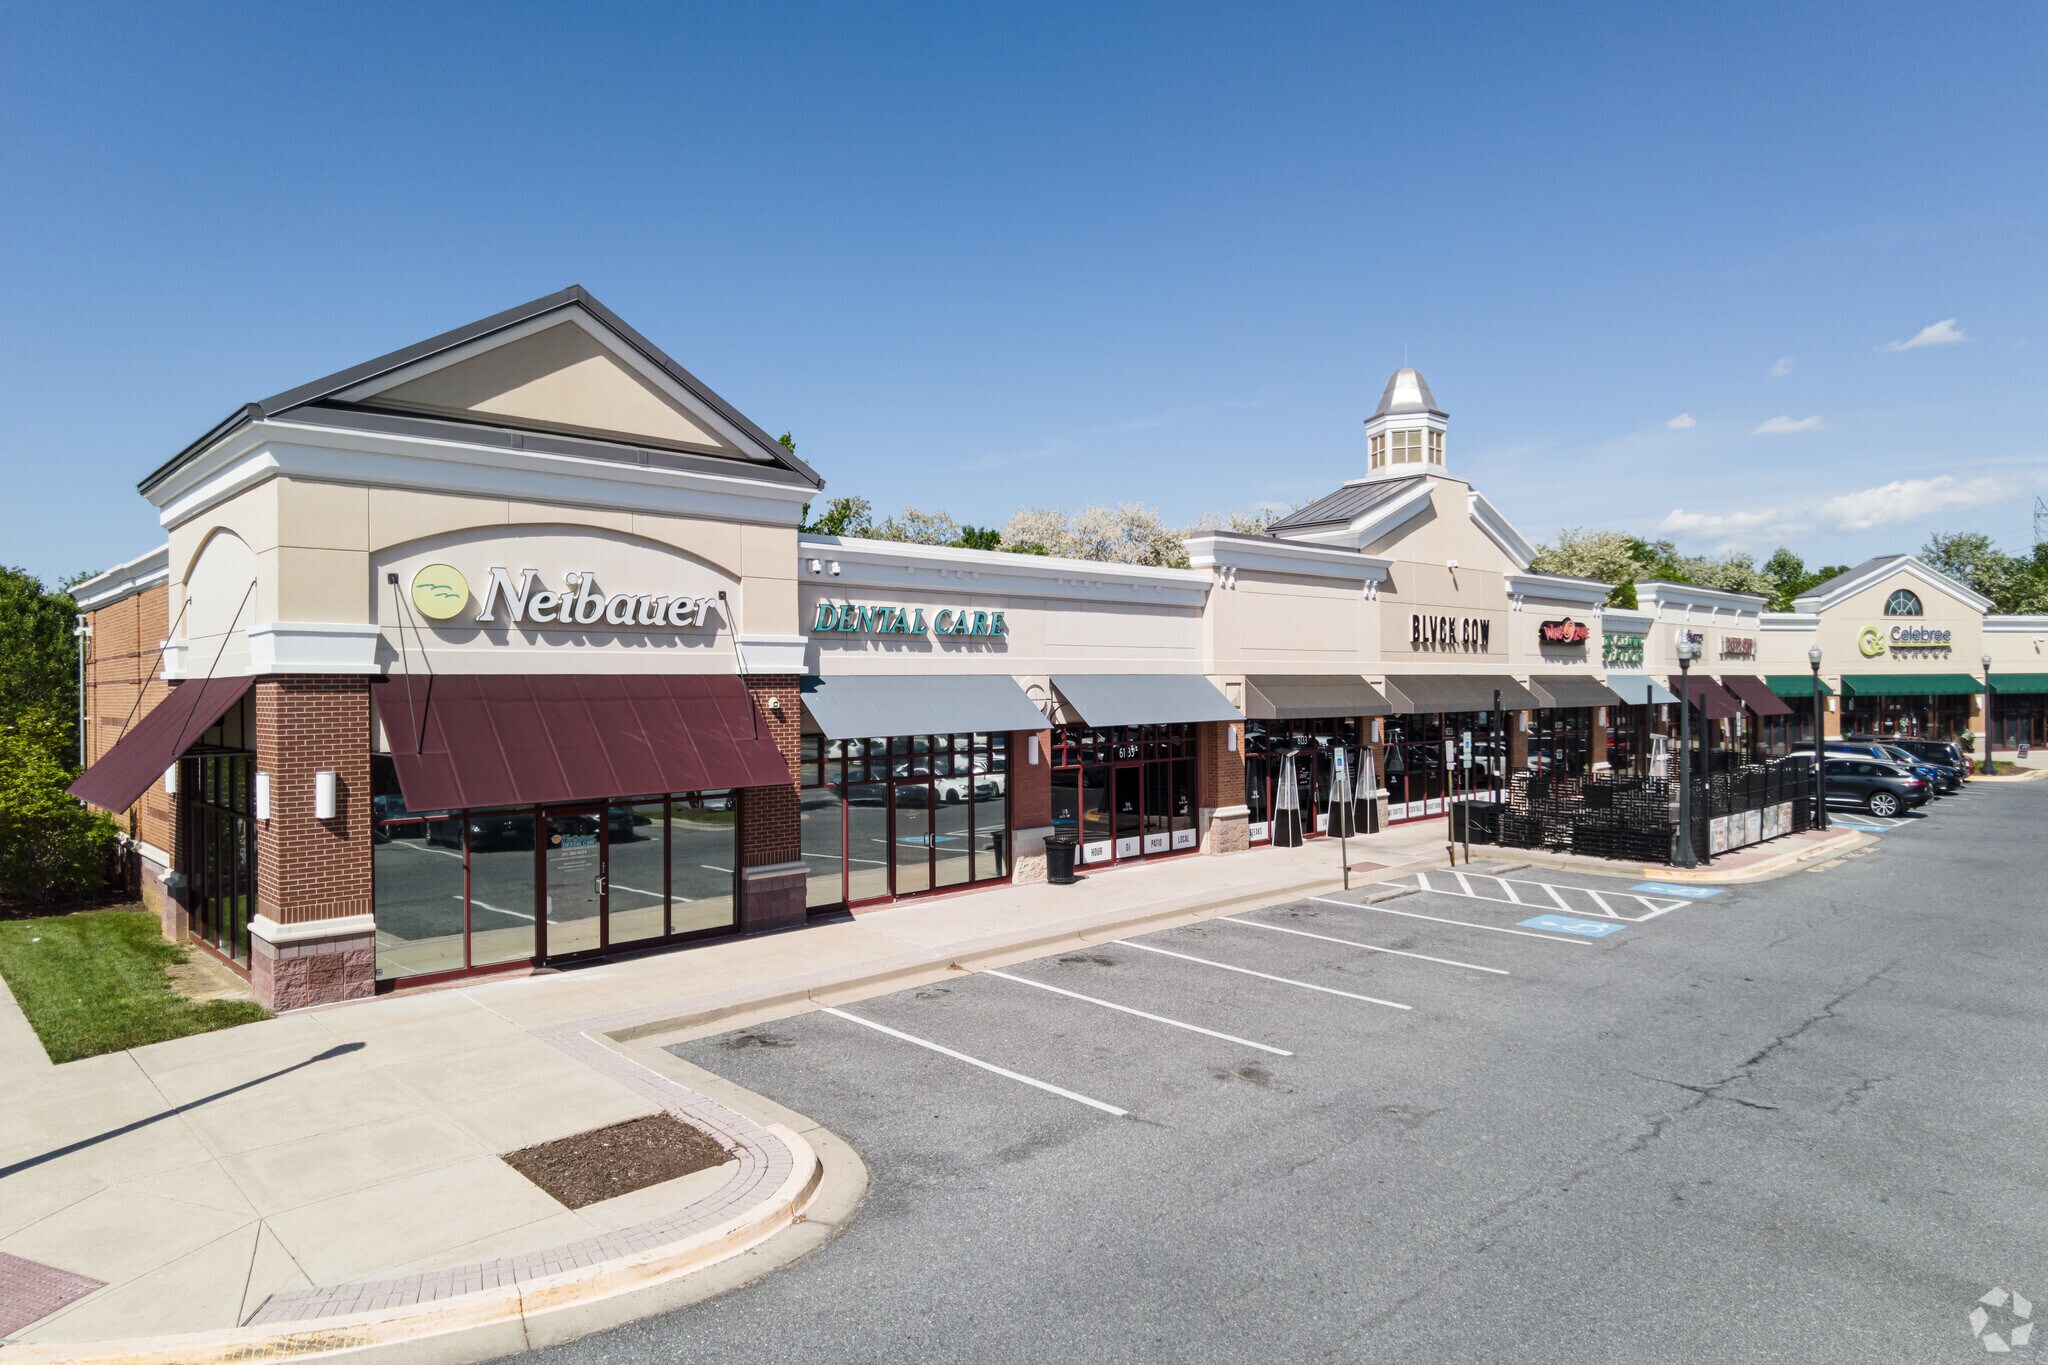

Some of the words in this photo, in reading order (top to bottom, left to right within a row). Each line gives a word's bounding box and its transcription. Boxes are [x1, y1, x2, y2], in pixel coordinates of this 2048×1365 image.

[476, 567, 717, 627] Neibauer
[813, 604, 928, 635] DENTAL
[934, 608, 1006, 636] CARE
[1412, 614, 1457, 643] BLVCK
[1462, 617, 1490, 645] COW
[1891, 625, 1951, 641] Celebree
[1151, 839, 1162, 847] PATIO
[1178, 834, 1190, 843] LOCAL
